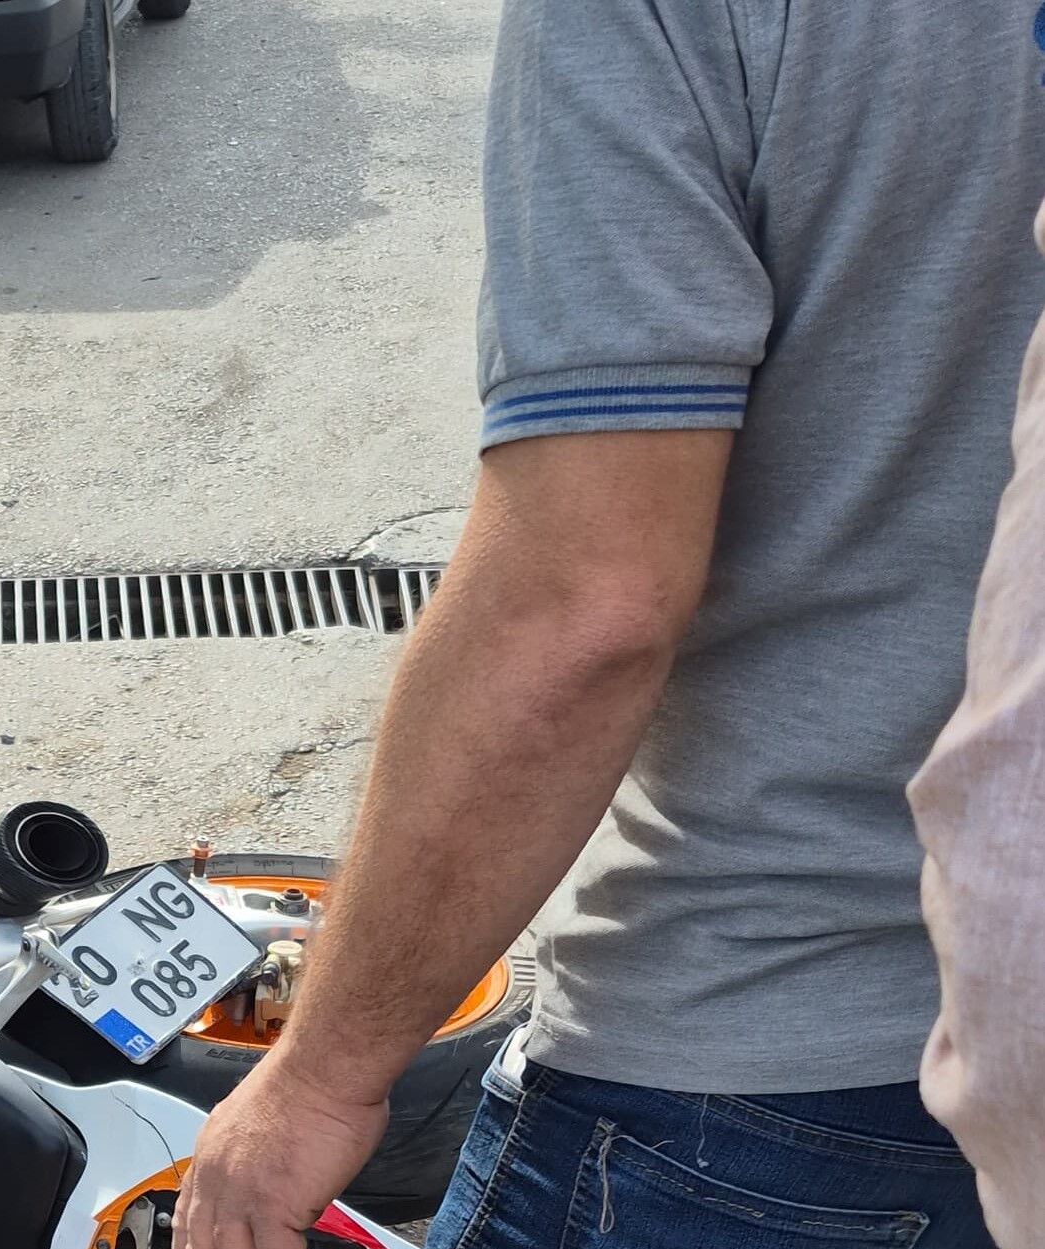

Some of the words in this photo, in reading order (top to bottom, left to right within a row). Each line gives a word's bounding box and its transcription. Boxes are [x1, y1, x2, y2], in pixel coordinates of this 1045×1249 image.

[120, 881, 195, 943] NG
[130, 939, 217, 1017] 085
[126, 1035, 151, 1056] TR
